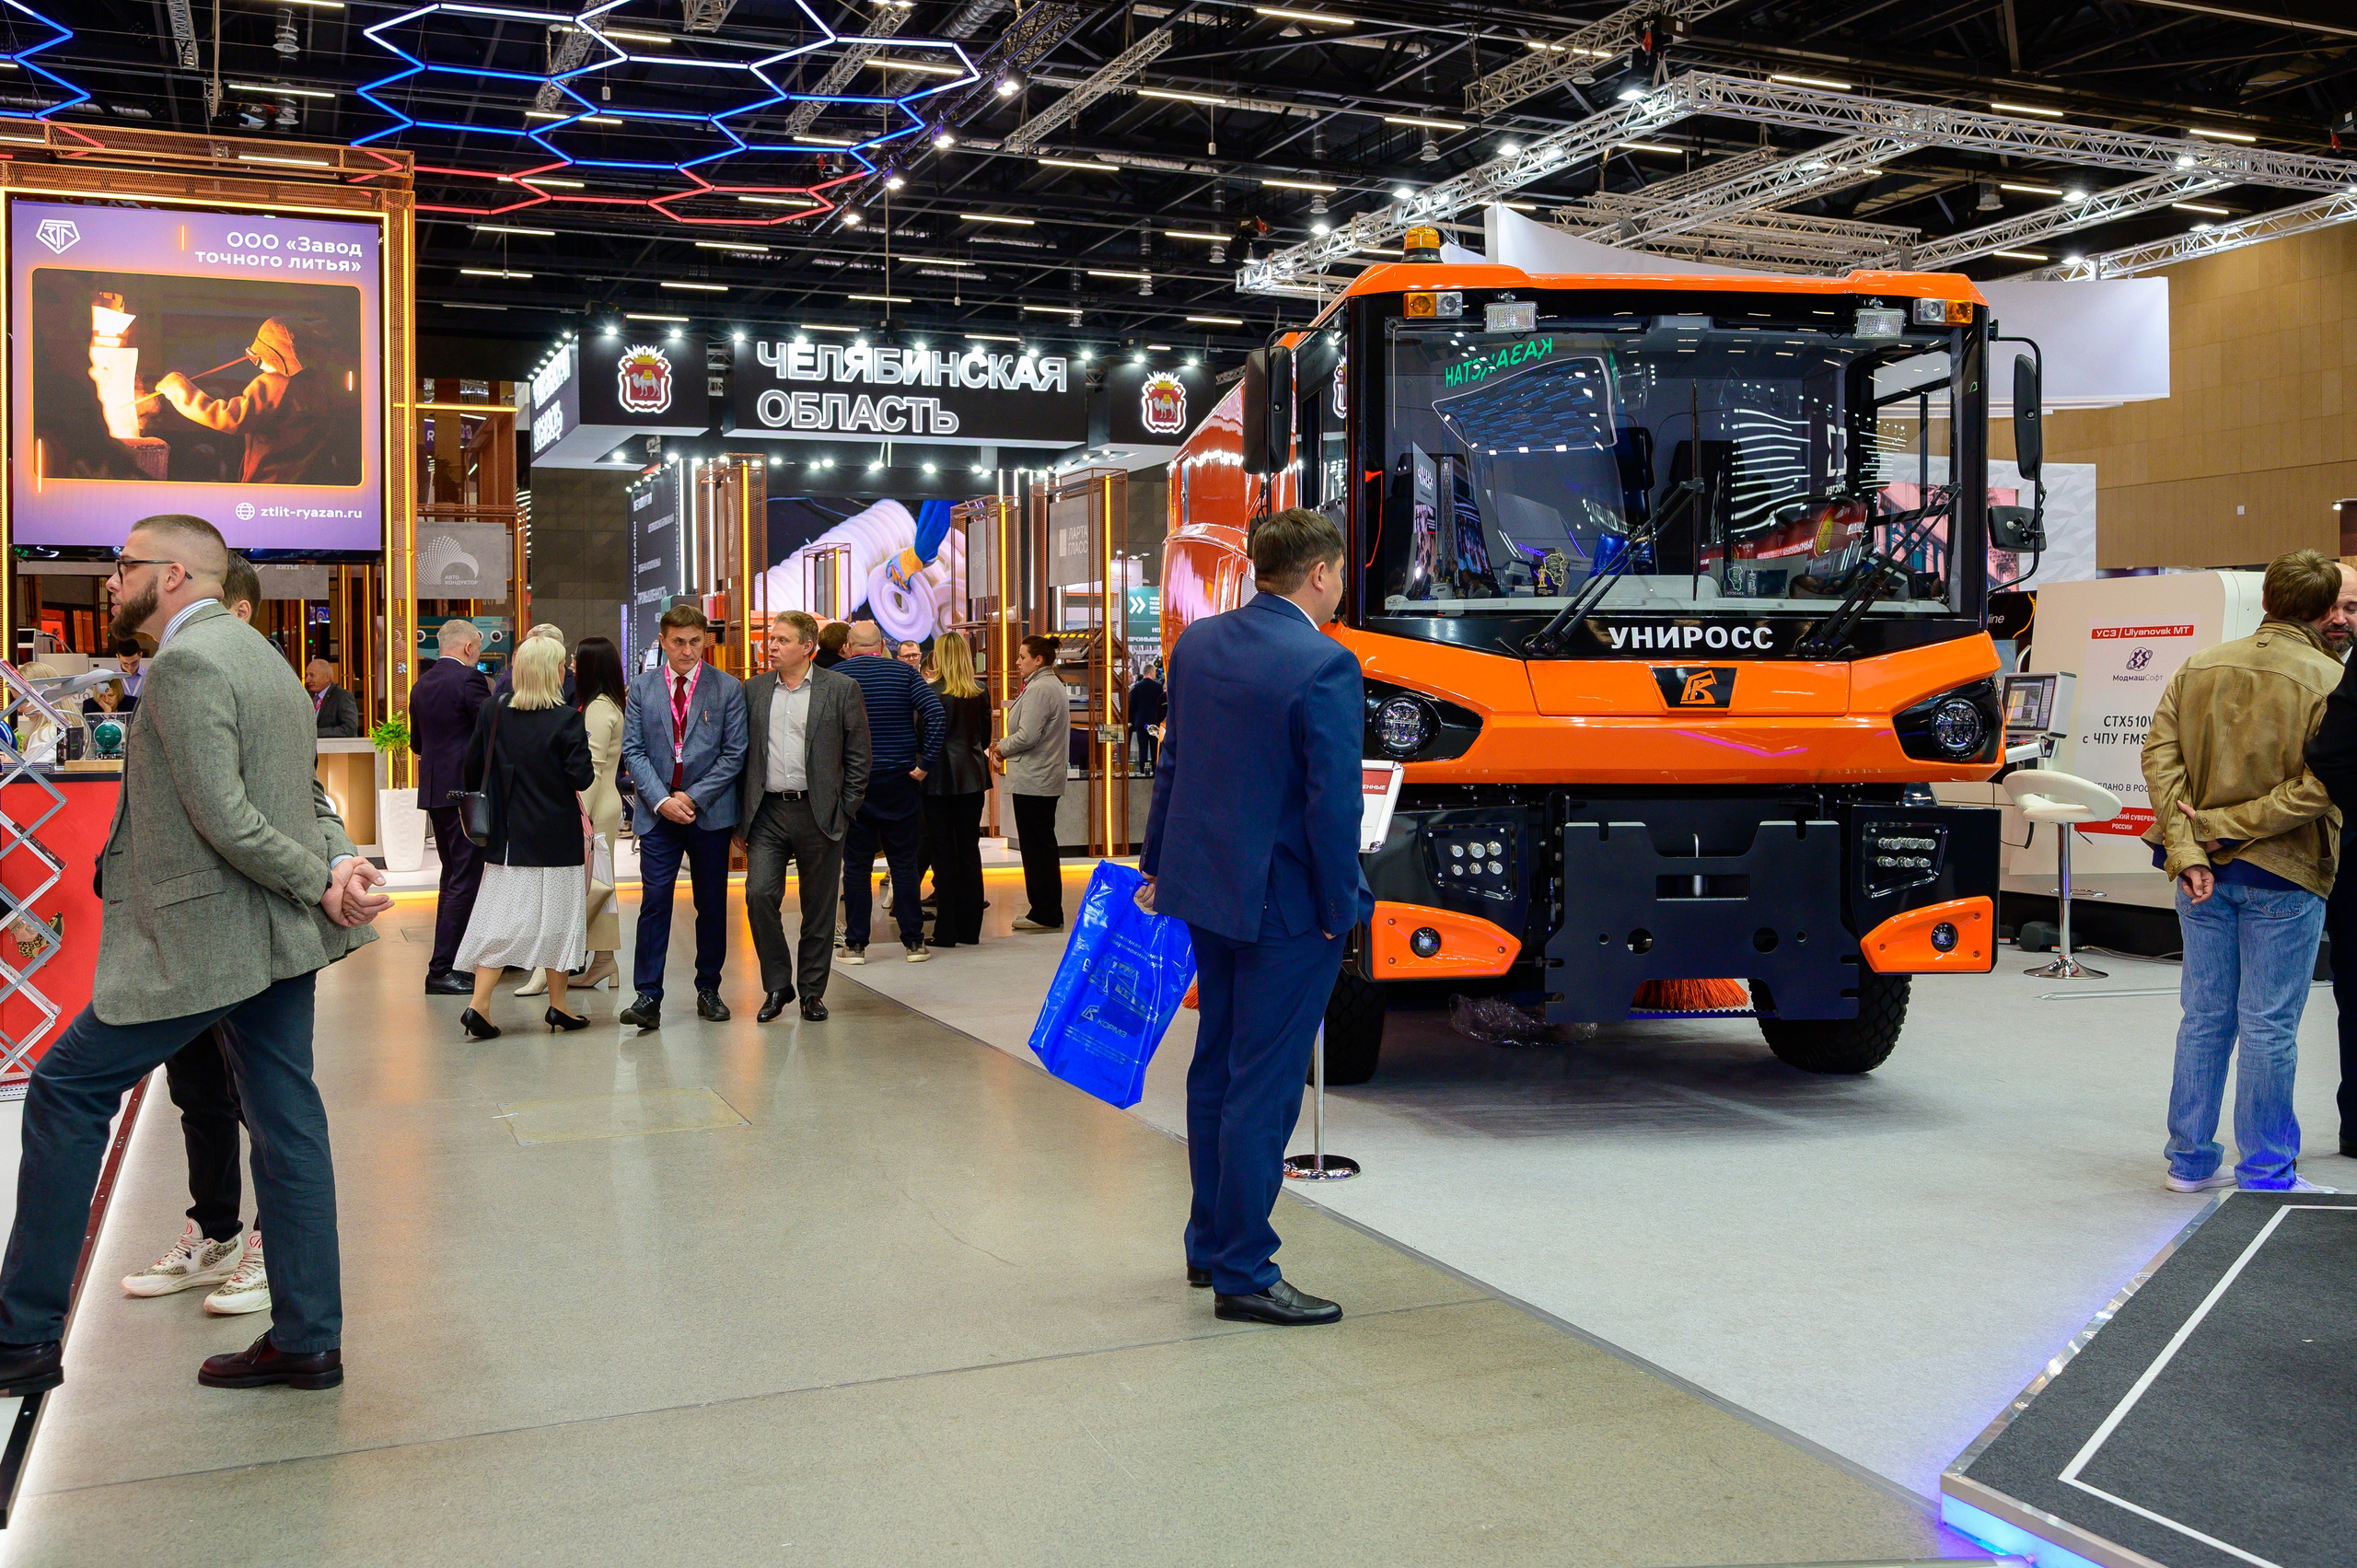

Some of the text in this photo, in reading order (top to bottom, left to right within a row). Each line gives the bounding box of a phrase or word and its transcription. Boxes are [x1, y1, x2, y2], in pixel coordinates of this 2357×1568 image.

[226, 231, 363, 258] ООО «Завод
[194, 250, 362, 272] точного литья»
[757, 342, 1067, 392] ЧЕЛЯБИНСКАЯ
[757, 389, 959, 435] ОБЛАСТЬ
[261, 505, 363, 520] ztlit-ryazan.ru
[1068, 525, 1088, 540] ЛАРТА
[1068, 540, 1088, 556] ГЛАСС
[1608, 626, 1773, 649] УНИРОСС
[2124, 628, 2171, 637] Ulyanovsk
[2112, 673, 2164, 682] МодмашСофт
[2094, 733, 2119, 744] ЧПУ
[1097, 1018, 1128, 1039] КОРМЗ
